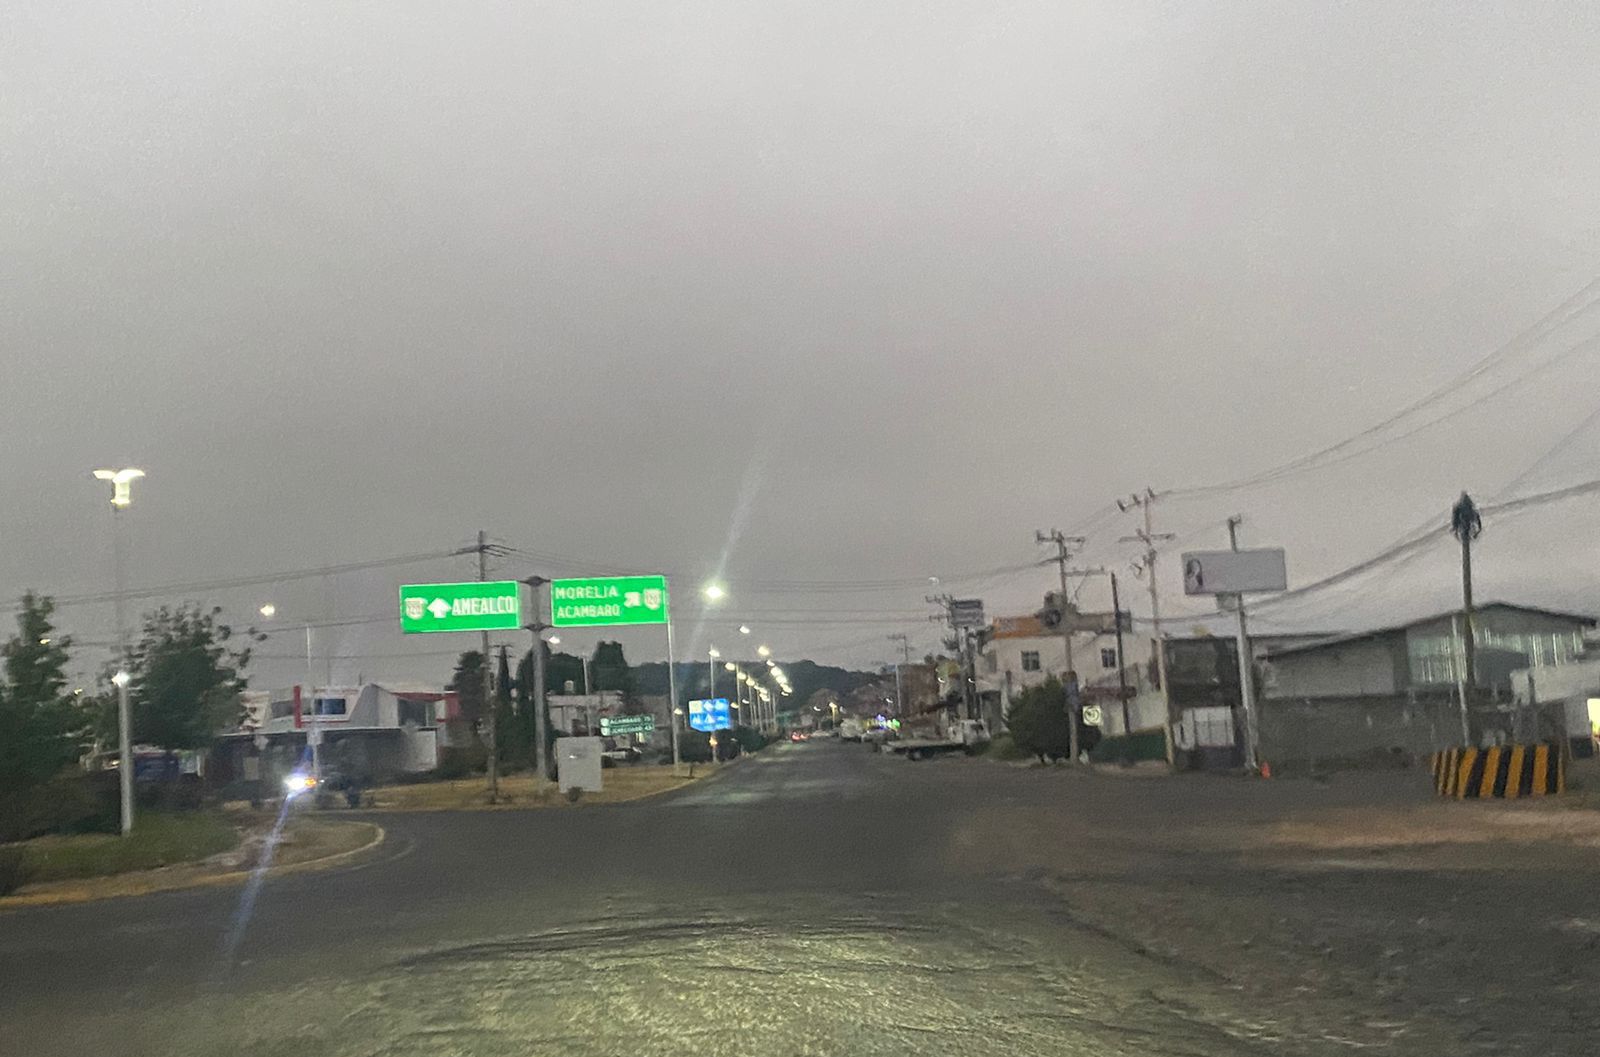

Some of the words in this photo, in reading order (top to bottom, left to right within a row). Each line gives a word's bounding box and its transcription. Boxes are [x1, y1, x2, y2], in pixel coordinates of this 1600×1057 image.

[555, 586, 618, 599] MORELIA
[452, 596, 516, 616] AMEALCO
[557, 604, 620, 618] ACAMBARO
